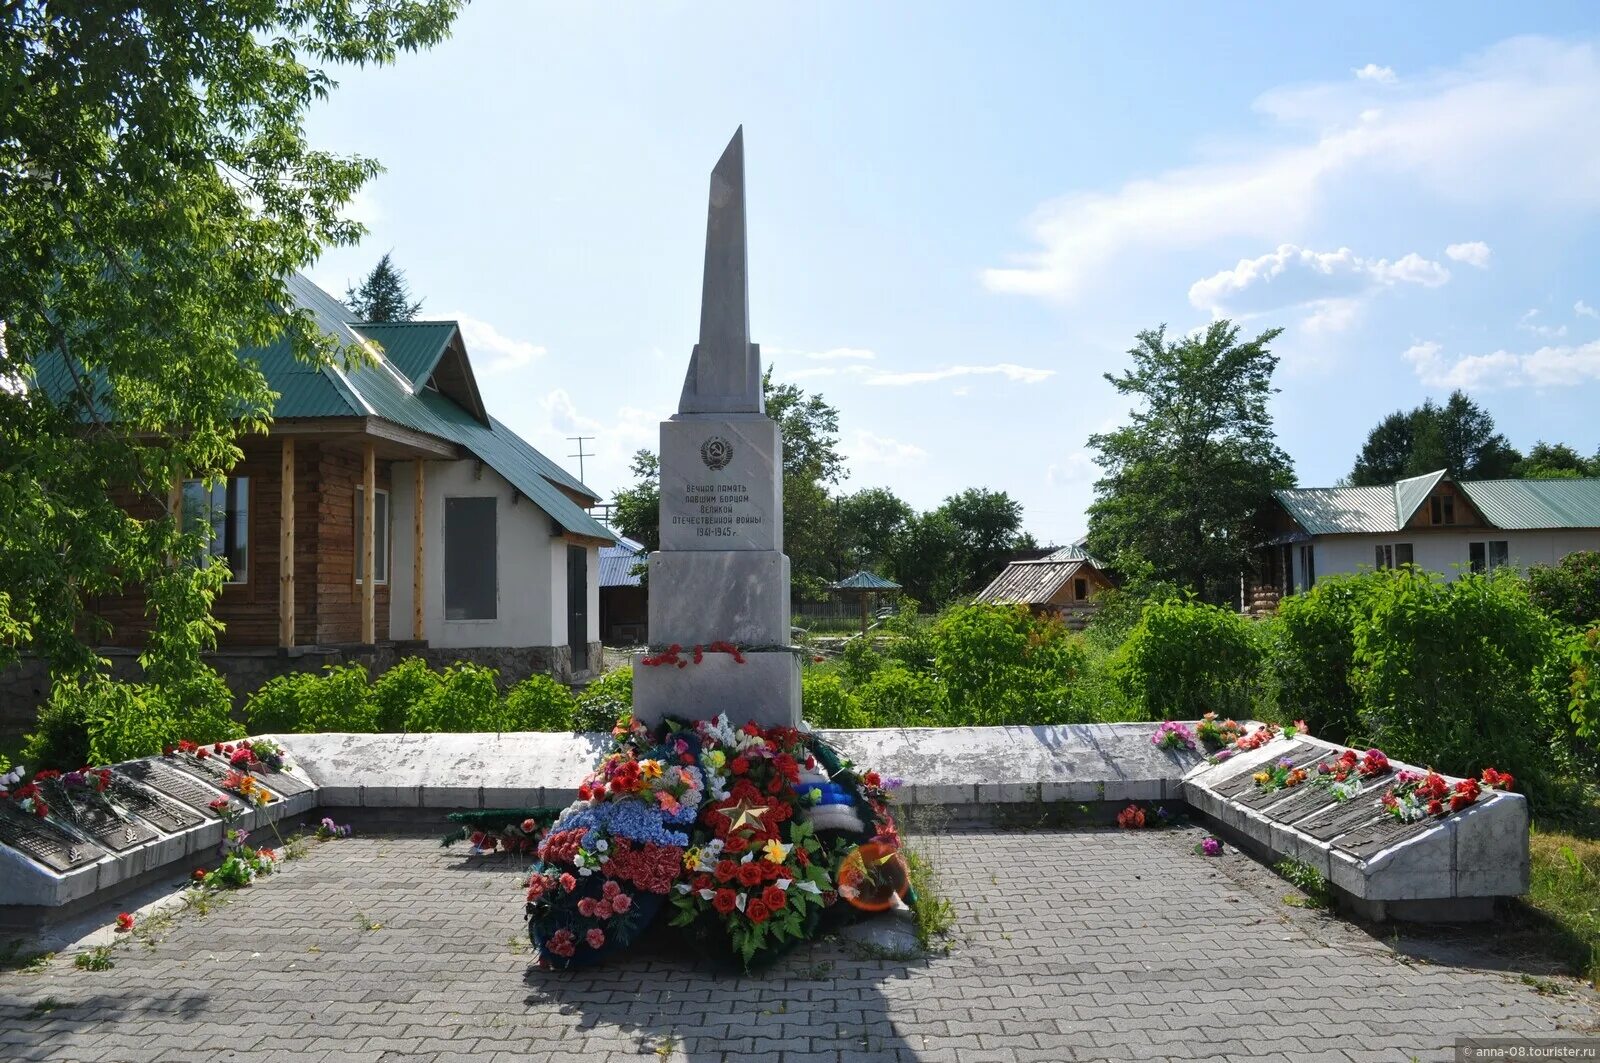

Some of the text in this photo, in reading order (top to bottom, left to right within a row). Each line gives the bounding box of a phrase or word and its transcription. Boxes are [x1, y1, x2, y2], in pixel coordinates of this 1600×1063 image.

[686, 484, 747, 493] ВЕЧНАЯ ПАМЯТЬ
[685, 495, 749, 504] ПАВШИМ БОРЦАМ
[700, 504, 733, 513] ВЕЛИКОЙ
[672, 514, 762, 525] ОТЕЧЕСТВЕННОЙ ВОЙНЫ
